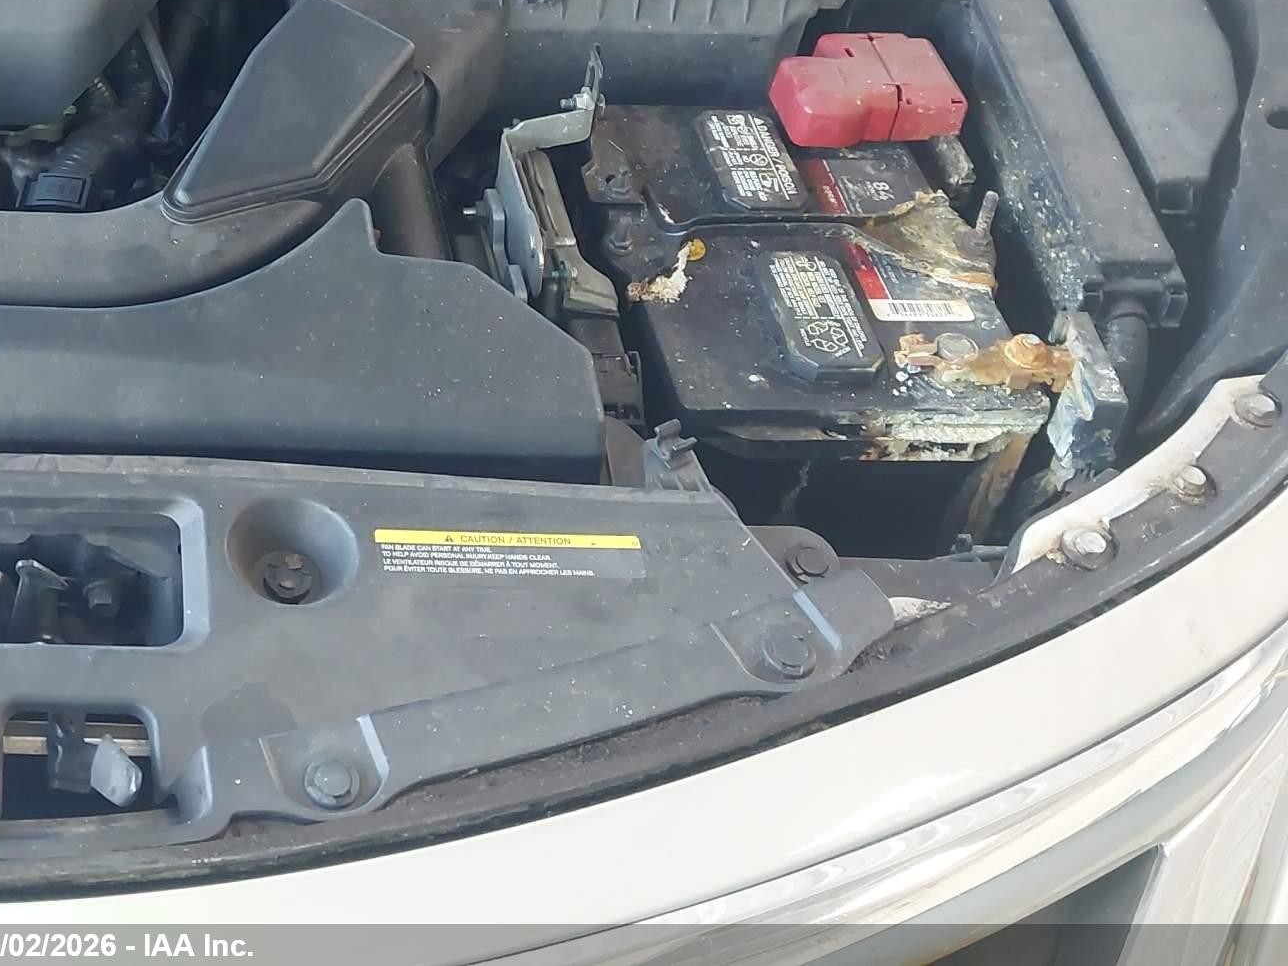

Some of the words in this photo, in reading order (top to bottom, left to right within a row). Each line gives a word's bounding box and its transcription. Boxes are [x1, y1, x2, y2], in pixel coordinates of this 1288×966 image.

[757, 124, 780, 157] DANGER
[775, 164, 798, 194] POISON
[872, 181, 895, 201] 84
[461, 535, 504, 543] CAUTION
[517, 537, 571, 545] ATTENTION
